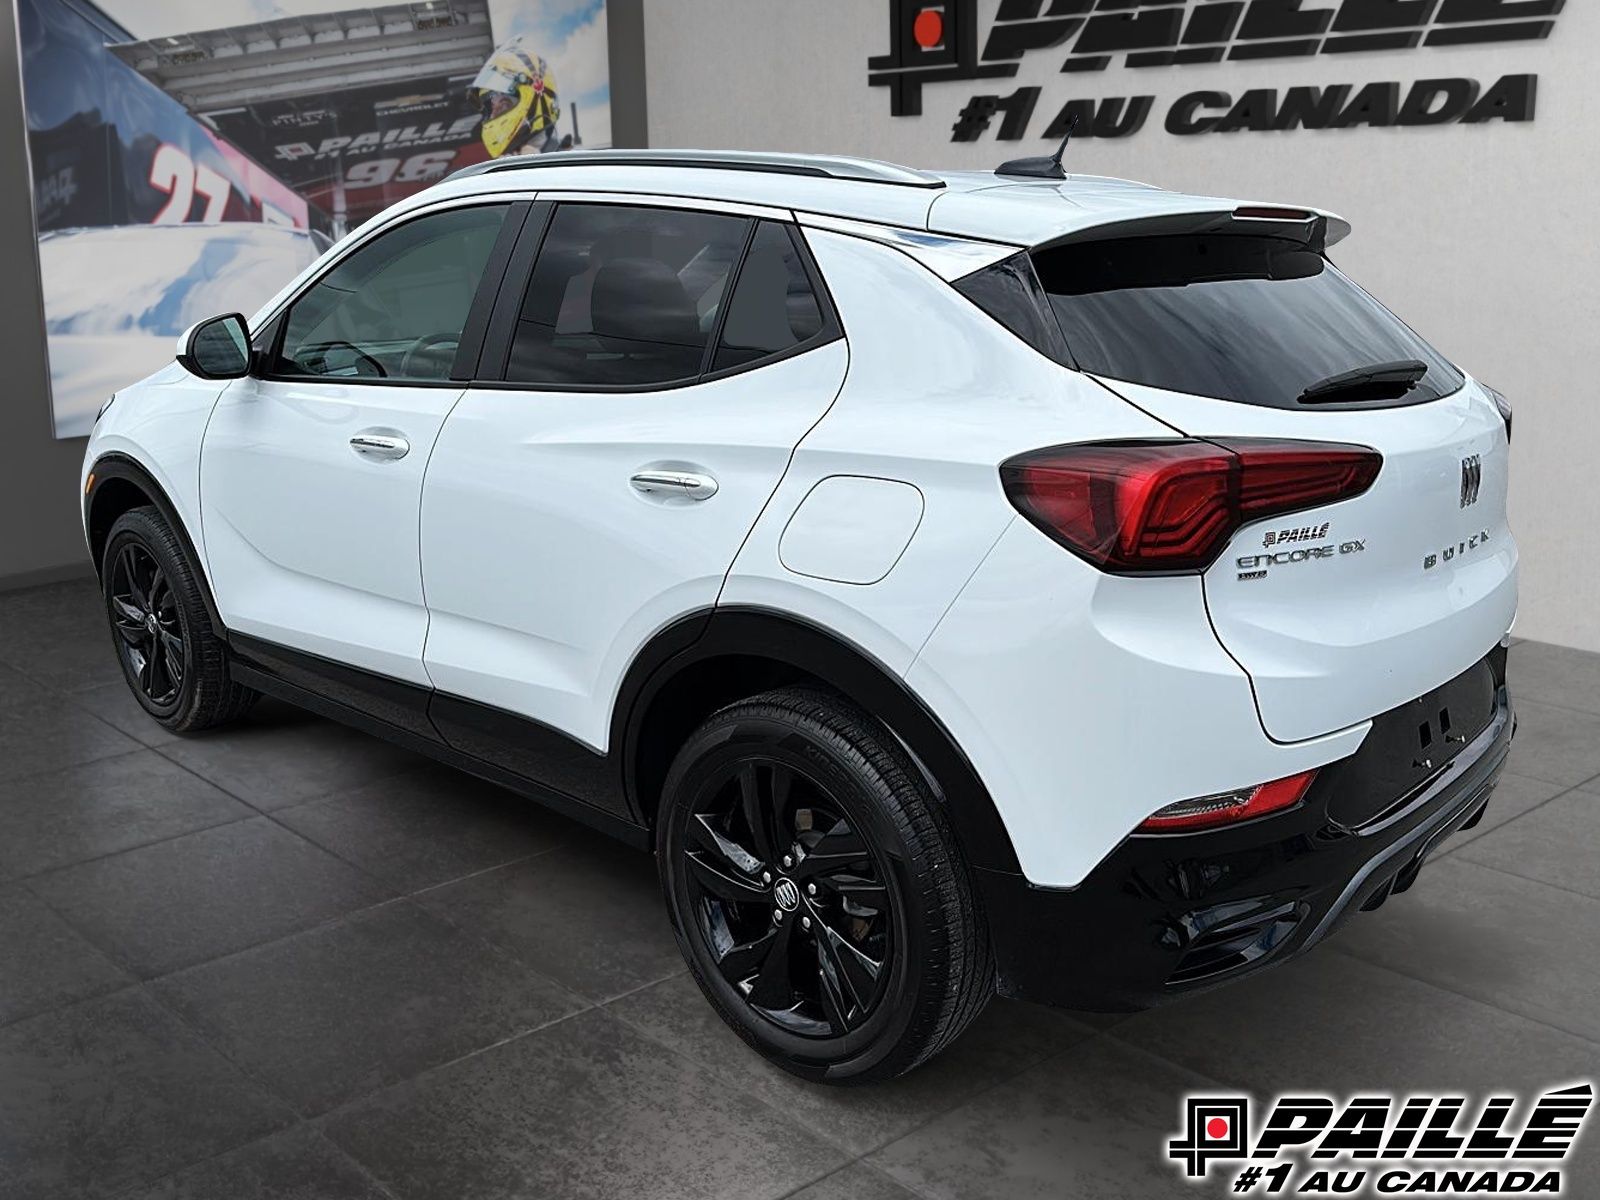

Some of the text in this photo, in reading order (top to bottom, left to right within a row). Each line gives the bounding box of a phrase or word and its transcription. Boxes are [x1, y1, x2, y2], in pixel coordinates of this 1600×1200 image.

[375, 102, 448, 117] CHEVROLET
[950, 74, 1538, 142] #1 AU CANADA
[346, 145, 374, 156] AU
[383, 133, 472, 150] CANADA
[150, 143, 231, 223] 27
[344, 150, 457, 189] 96
[1236, 539, 1365, 569] ENCORE GX
[1423, 527, 1490, 570] BUICK
